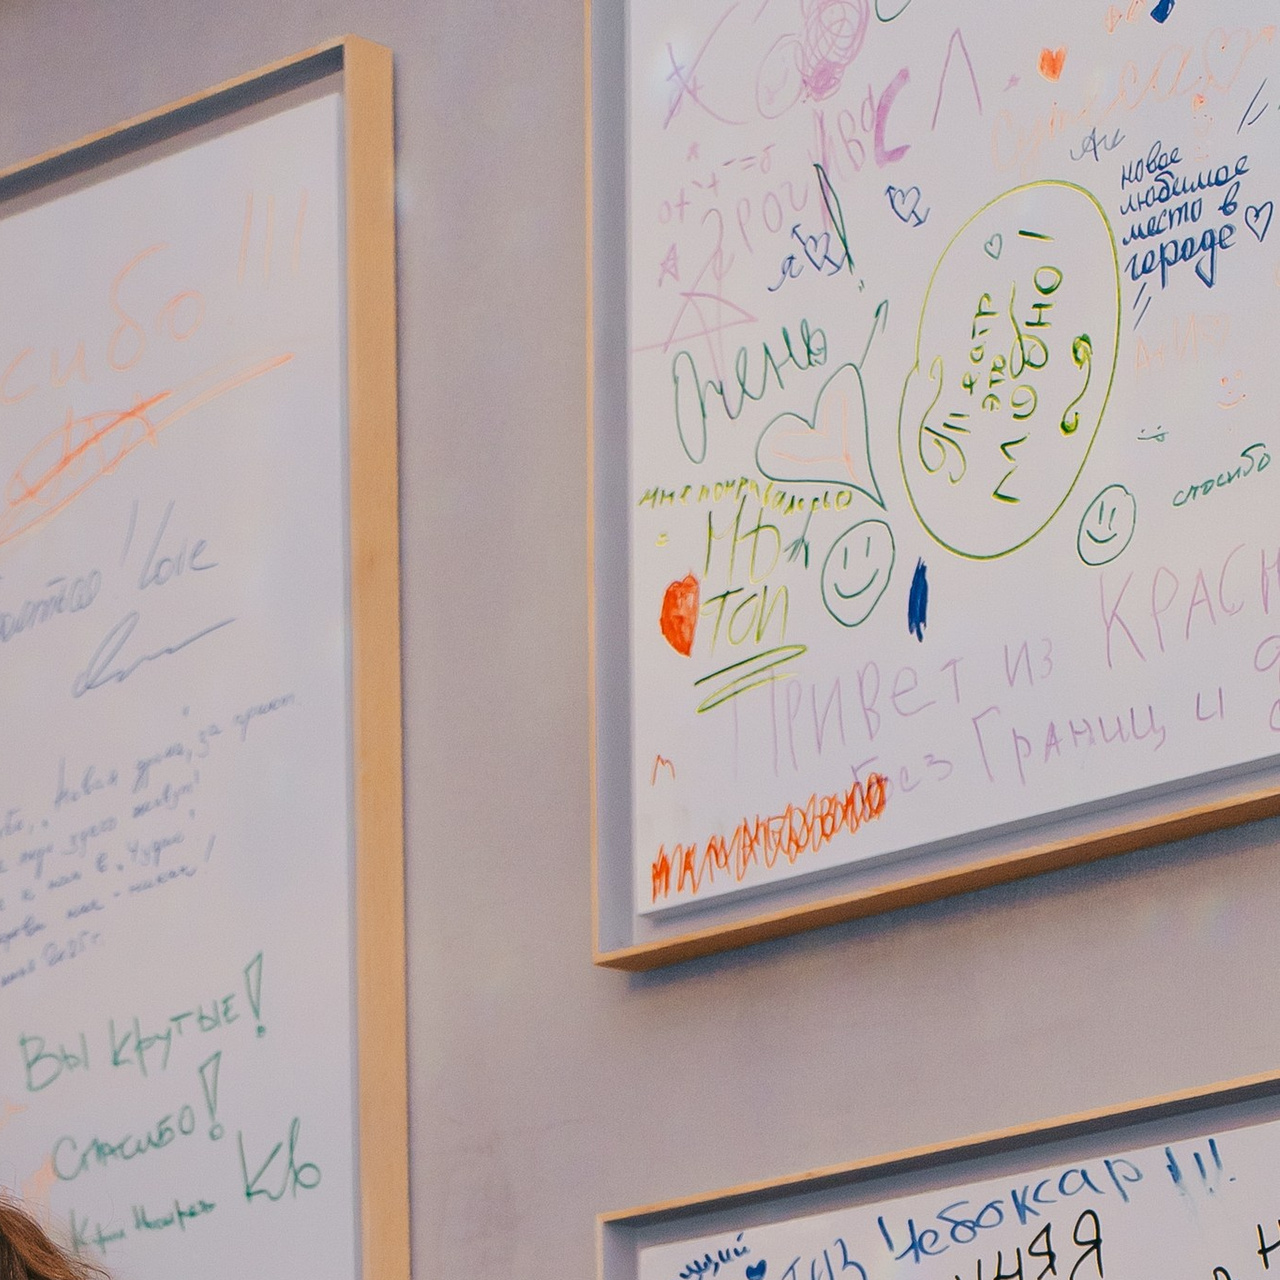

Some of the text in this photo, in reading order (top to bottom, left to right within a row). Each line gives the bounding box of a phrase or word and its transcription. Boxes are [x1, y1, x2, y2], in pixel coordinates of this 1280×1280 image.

[1120, 155, 1251, 216] любимое
[1122, 141, 1182, 190] новое
[1122, 181, 1241, 245] место в
[1125, 223, 1237, 289] городе
